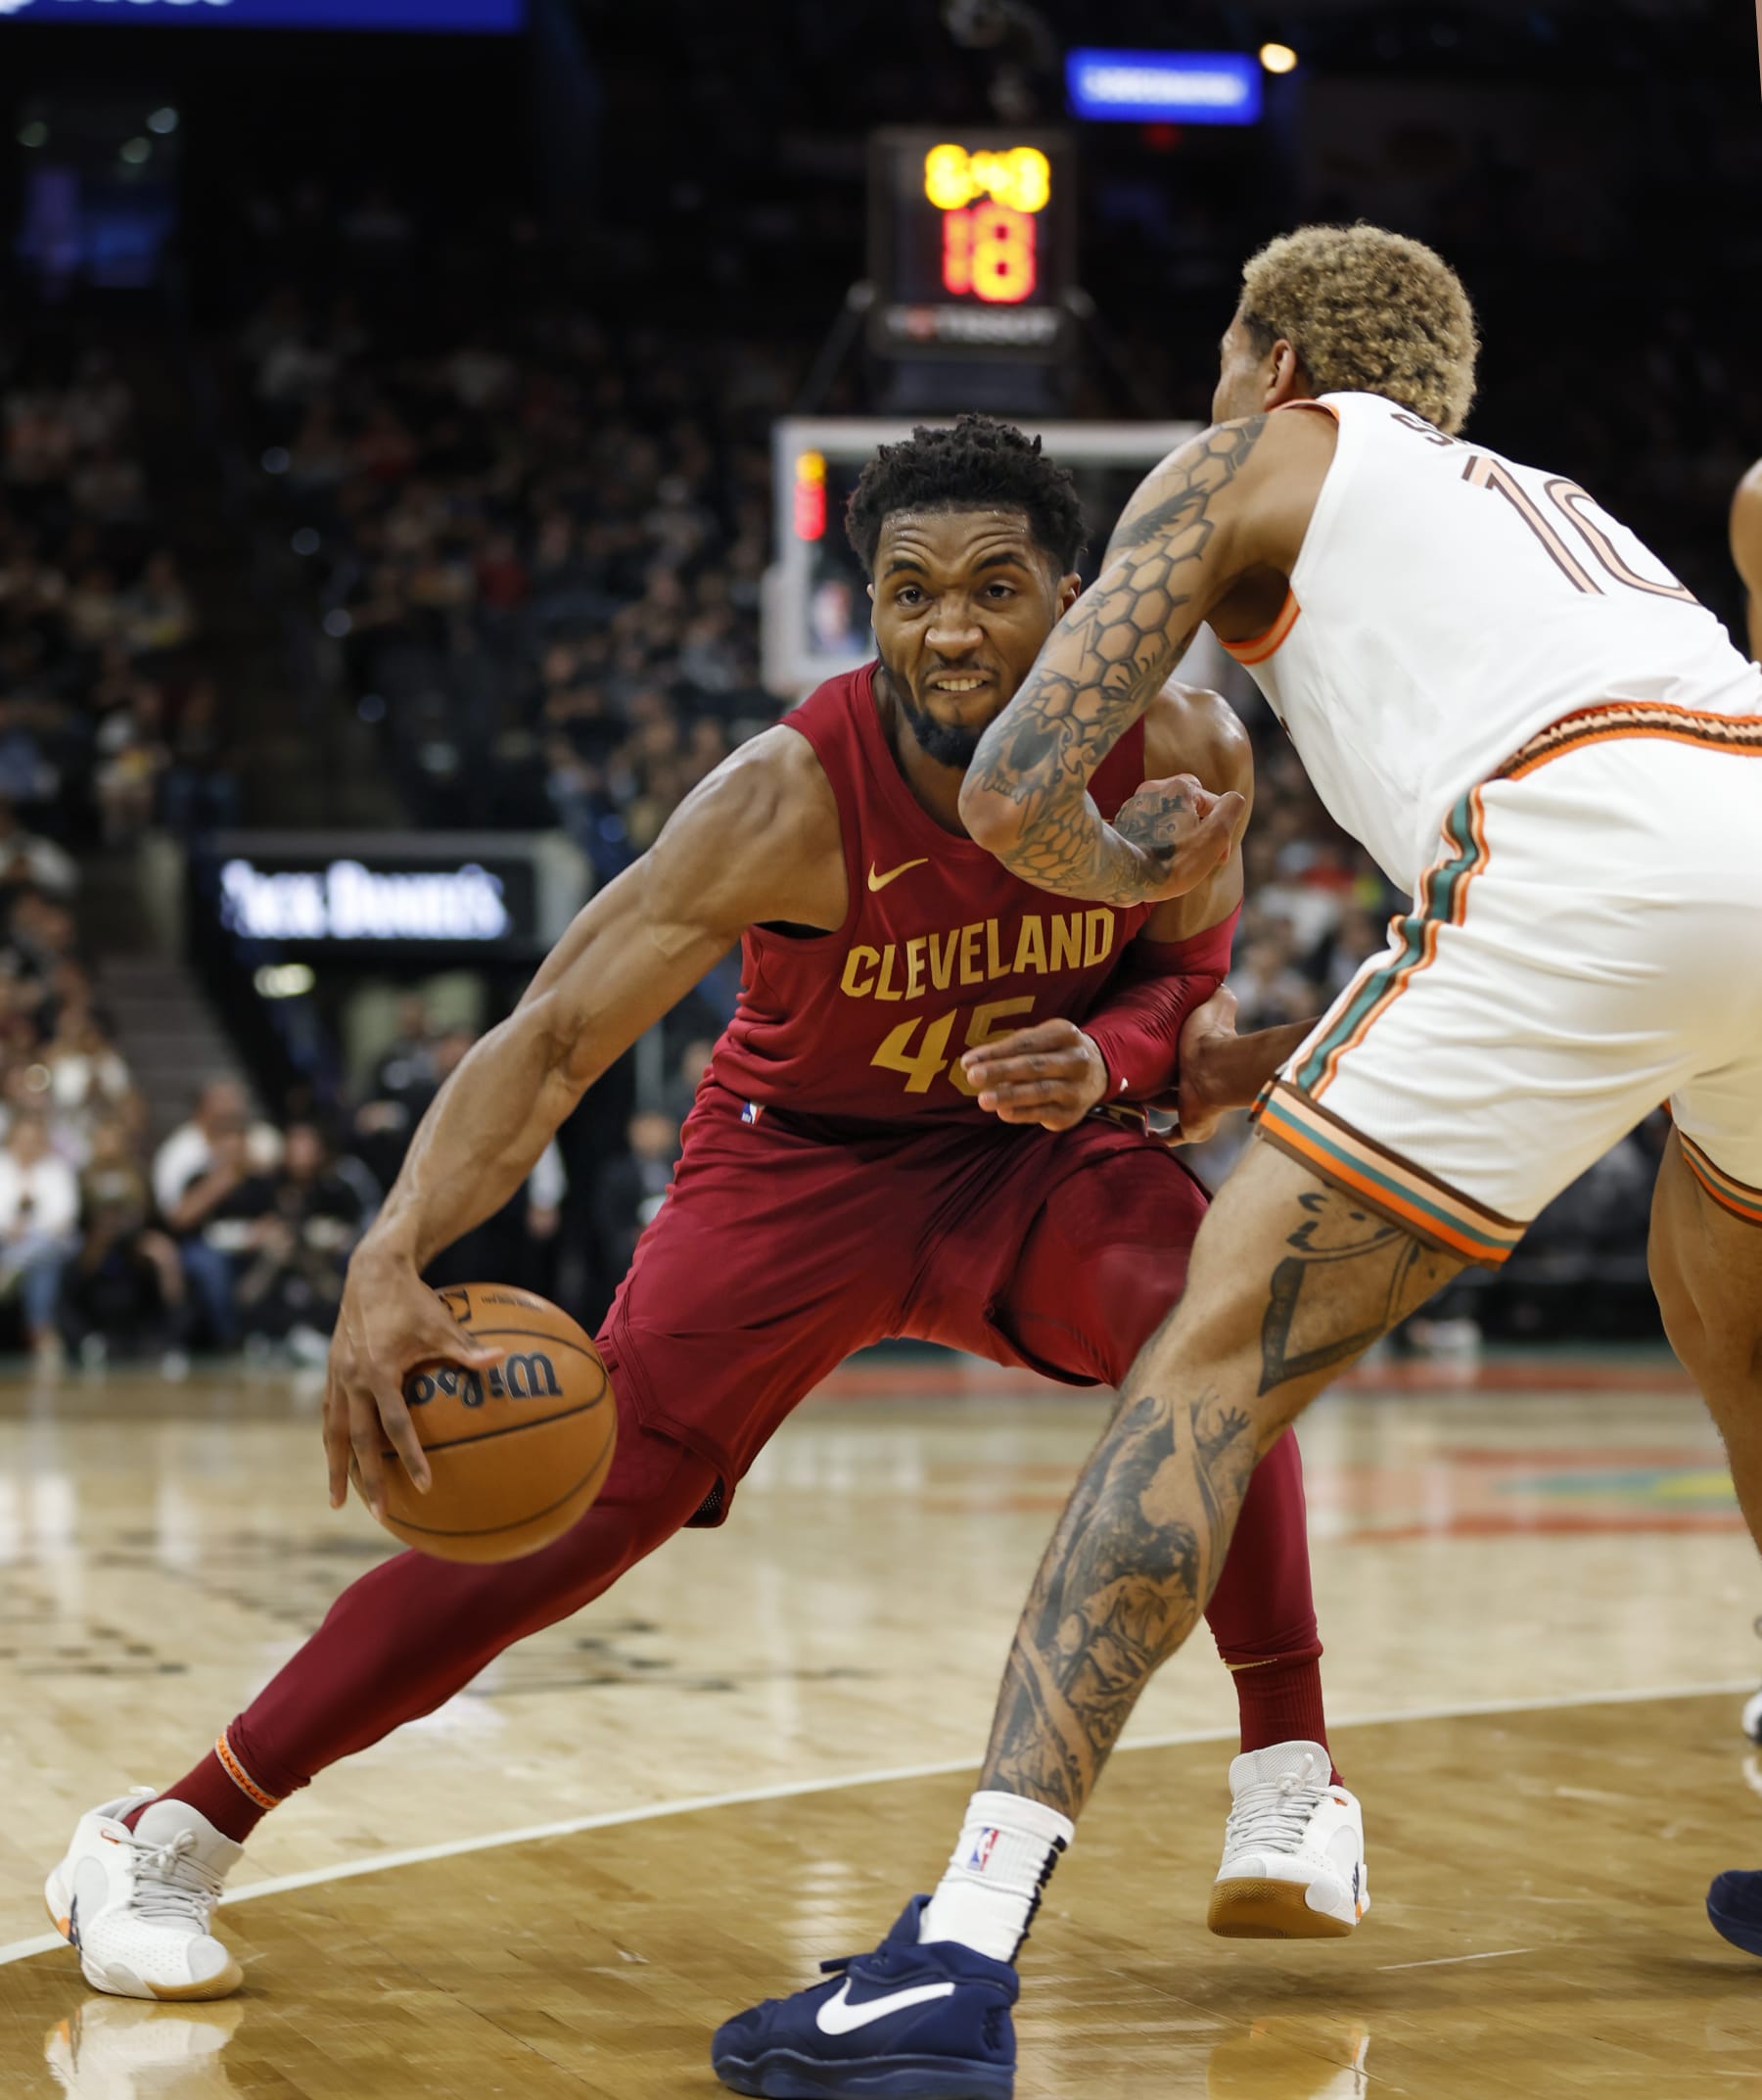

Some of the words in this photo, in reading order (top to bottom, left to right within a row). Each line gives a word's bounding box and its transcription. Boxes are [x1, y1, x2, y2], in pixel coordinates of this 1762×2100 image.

[942, 202, 1036, 303] 18
[1461, 454, 1704, 608] 10
[840, 907, 1115, 1002] CLEVELAND
[870, 996, 1036, 1097] 45
[407, 1352, 564, 1408] Wilso
